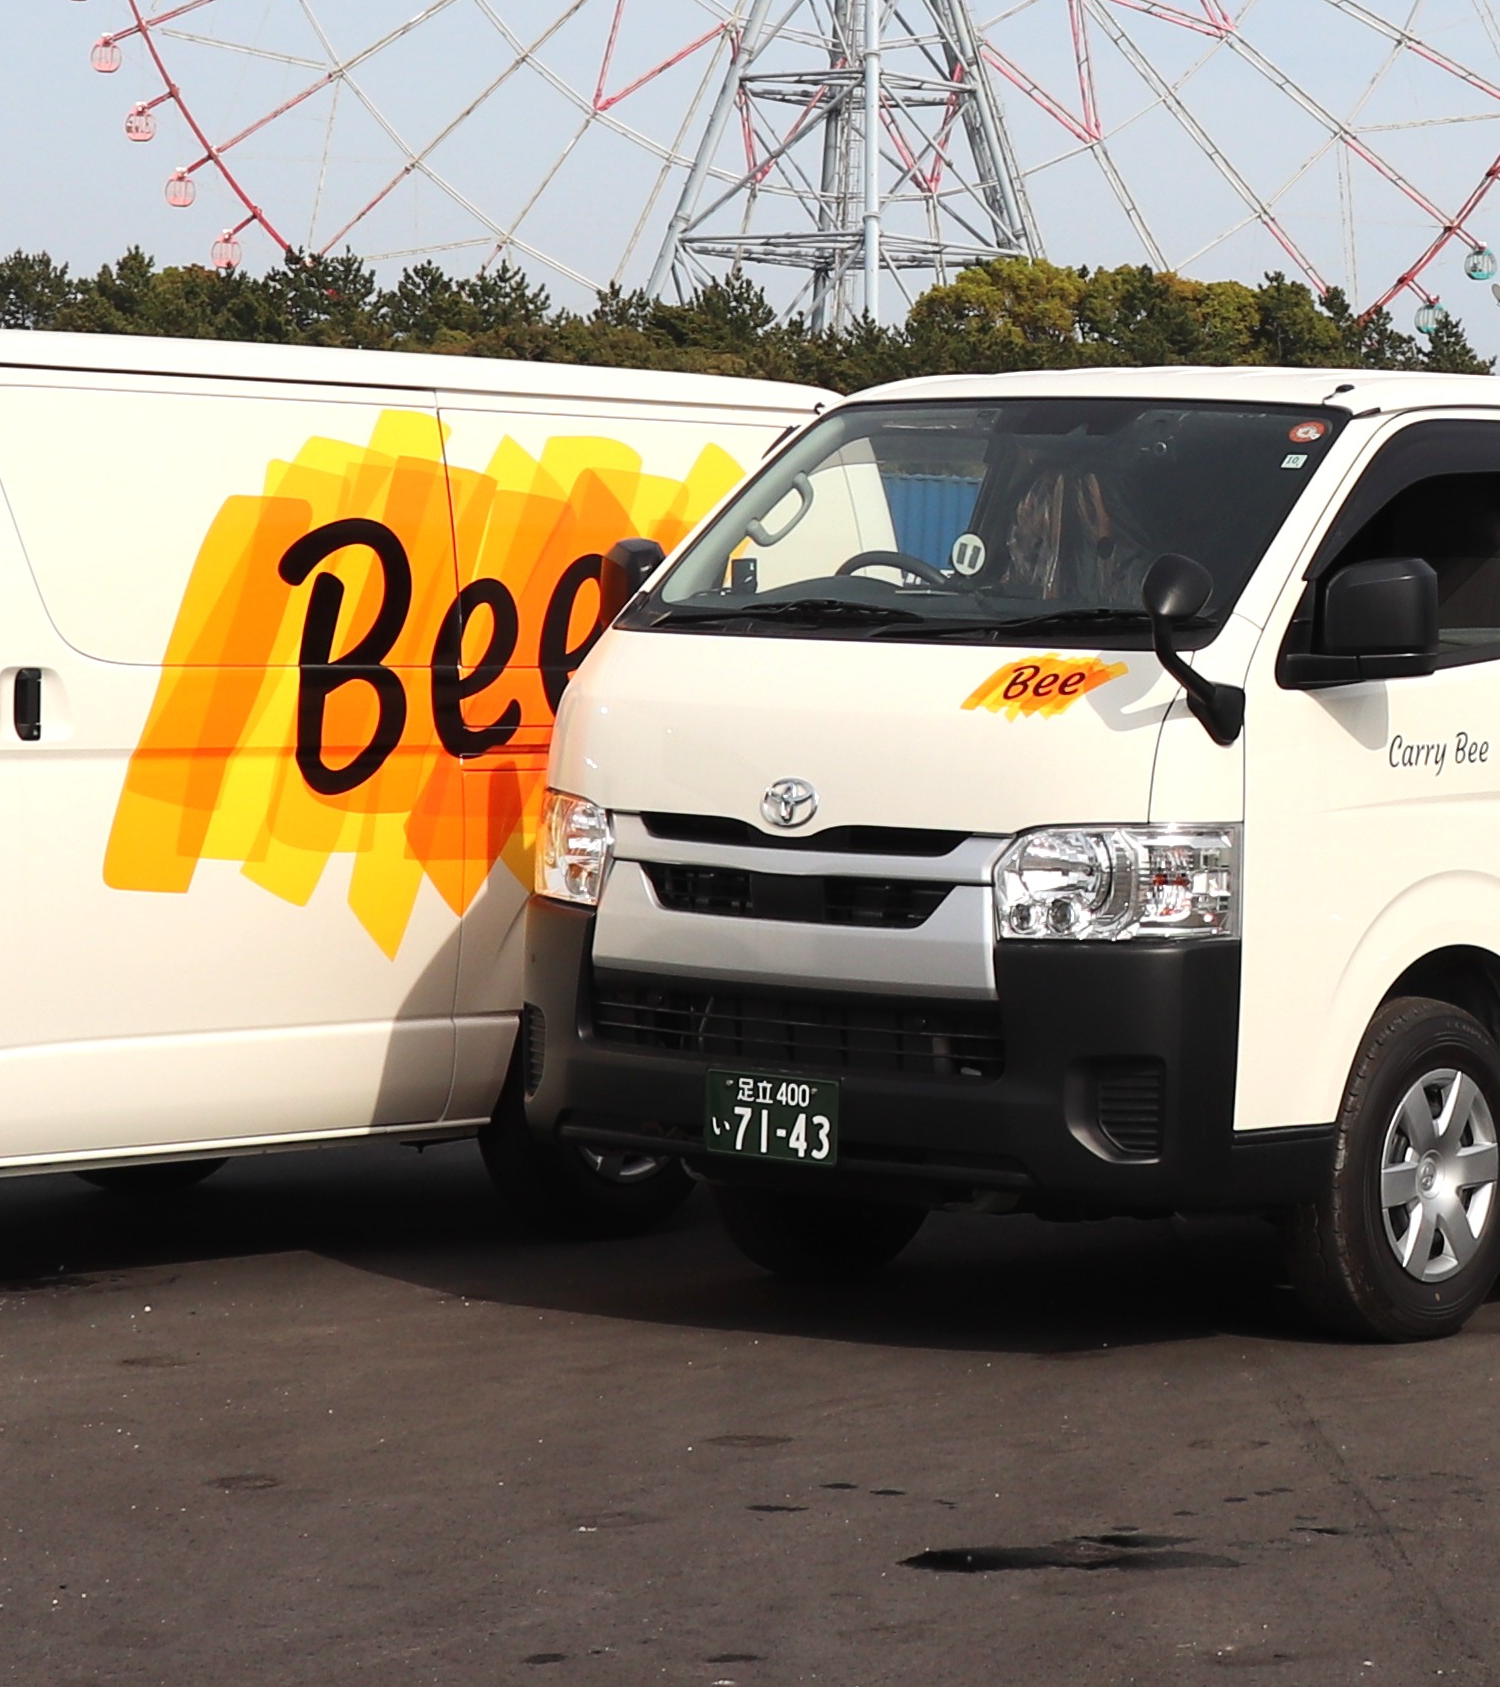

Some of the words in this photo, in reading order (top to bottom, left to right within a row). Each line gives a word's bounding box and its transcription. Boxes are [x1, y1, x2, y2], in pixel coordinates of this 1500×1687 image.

[1003, 664, 1086, 701] Bee
[1389, 734, 1447, 777] Carry
[1455, 731, 1489, 764] Bee
[712, 1116, 731, 1136] い
[734, 1106, 831, 1160] 71-43
